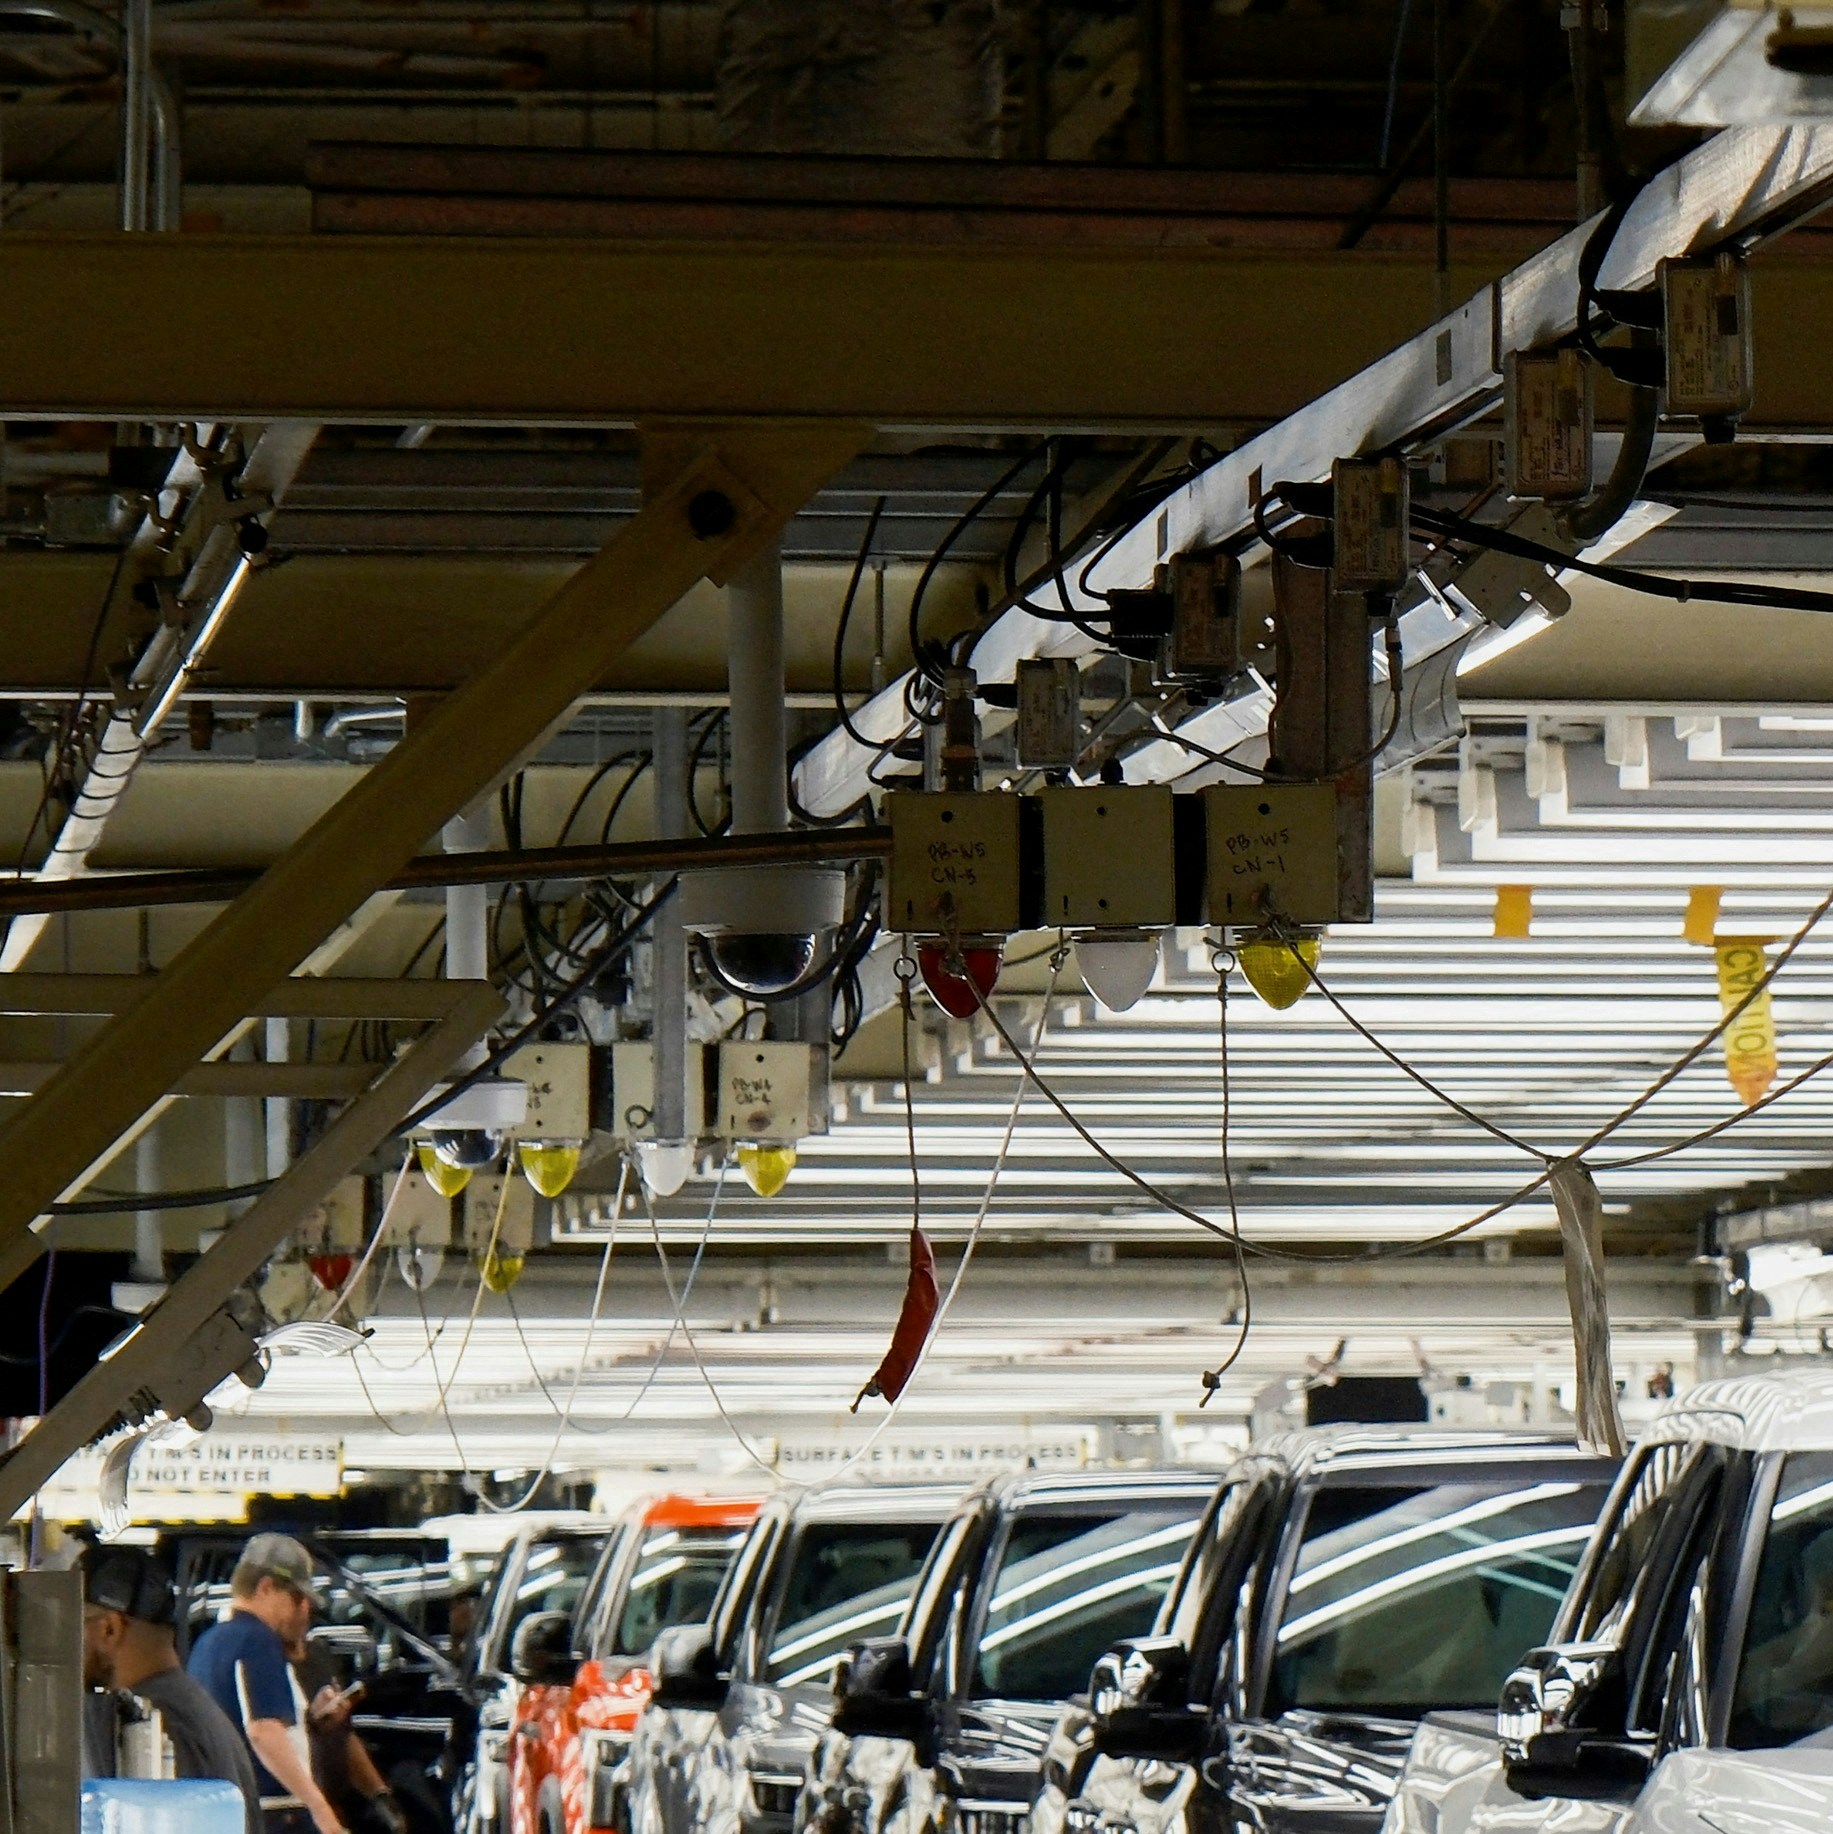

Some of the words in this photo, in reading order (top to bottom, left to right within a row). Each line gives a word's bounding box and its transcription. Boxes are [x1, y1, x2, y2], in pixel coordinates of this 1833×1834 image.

[209, 1446, 231, 1460] IN
[237, 1445, 338, 1461] PROCESS
[953, 1446, 973, 1461] IN
[147, 1468, 190, 1481] NOT
[199, 1468, 270, 1482] ENTER
